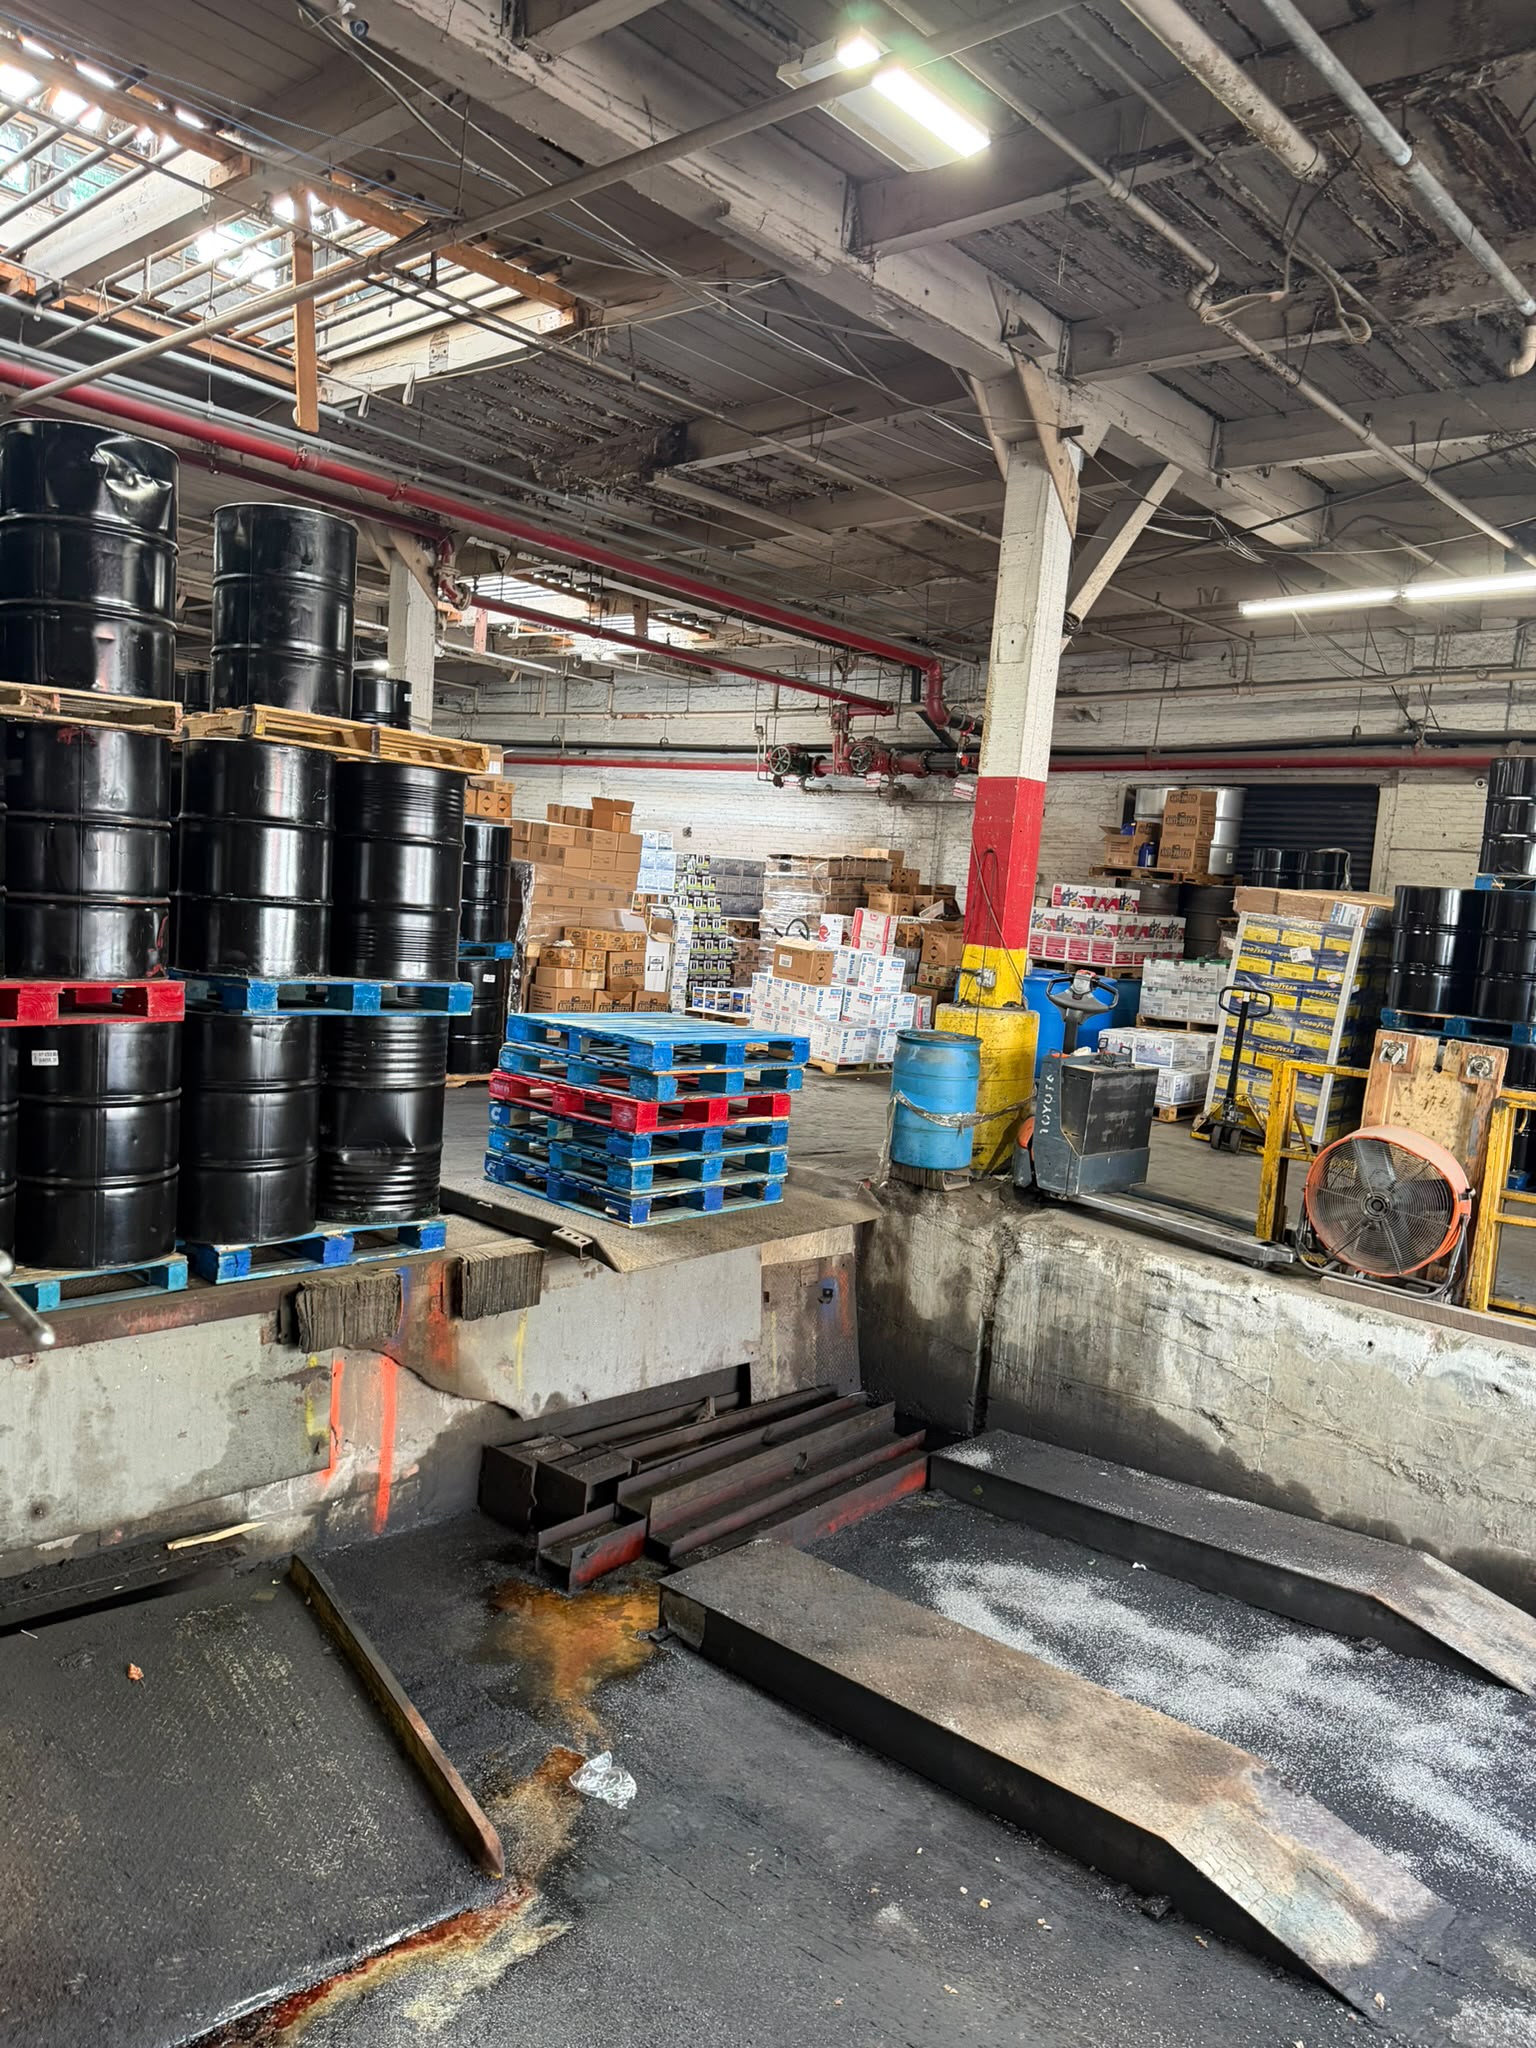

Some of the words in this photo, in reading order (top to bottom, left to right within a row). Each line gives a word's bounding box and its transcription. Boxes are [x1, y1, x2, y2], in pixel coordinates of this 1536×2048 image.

[613, 965, 644, 975] ANTI-FREEZE
[1261, 981, 1298, 991] GOODYEAR
[558, 1003, 592, 1012] ANTI-FREEZE
[843, 997, 851, 1012] Delo
[1299, 1019, 1334, 1030] GOODYEA
[1258, 1043, 1295, 1054] GOODYEAR
